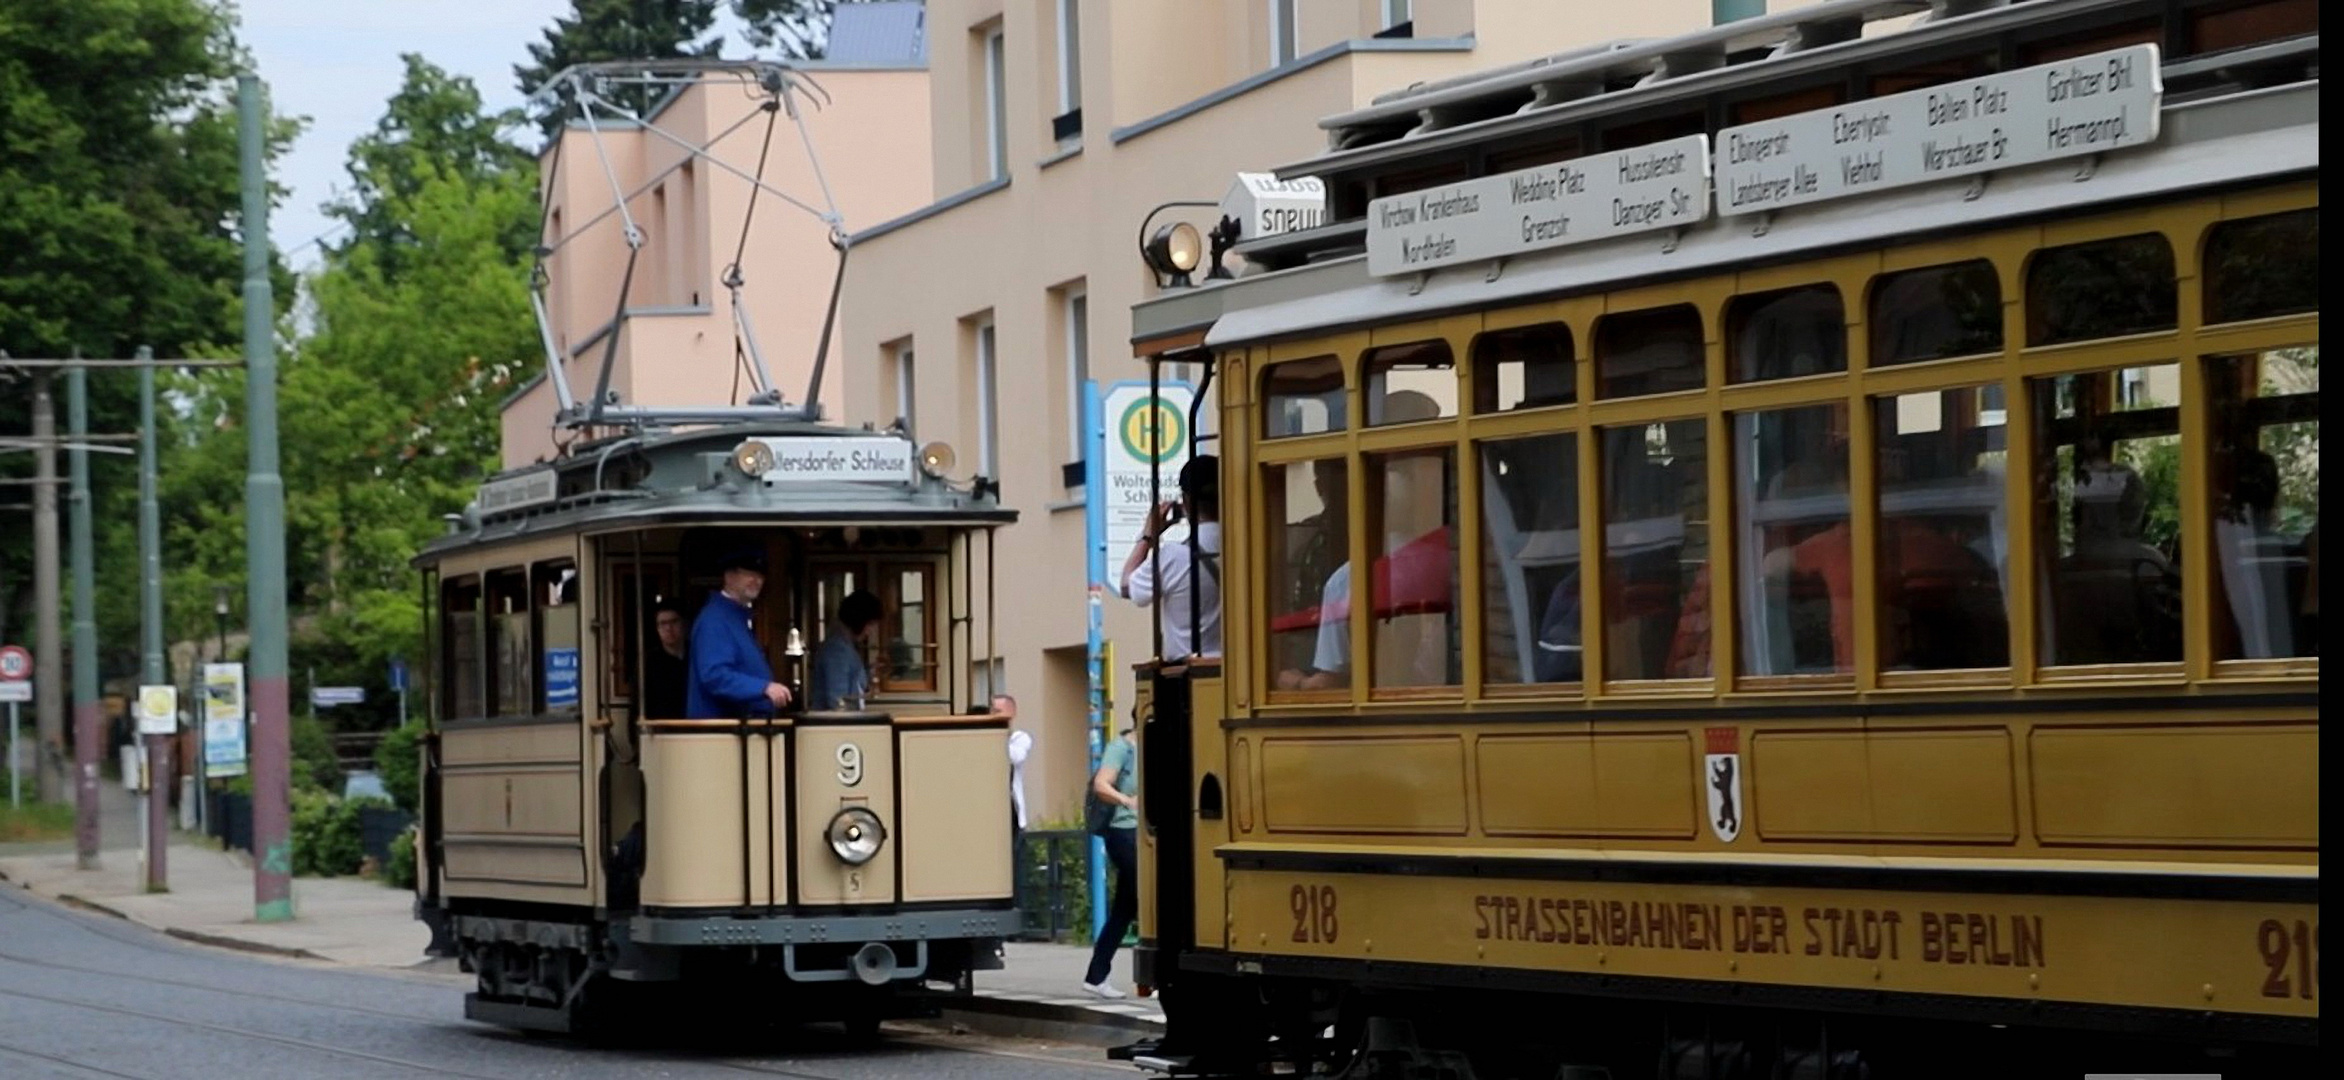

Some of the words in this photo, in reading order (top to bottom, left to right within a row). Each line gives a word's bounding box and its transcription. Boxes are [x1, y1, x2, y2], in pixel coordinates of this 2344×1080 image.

[1972, 84, 2008, 118] Platz
[1922, 135, 1989, 173] Warschauer
[1558, 165, 1585, 196] Platz
[1730, 171, 1791, 207] Landsberger
[1794, 163, 1818, 195] Allee
[1419, 189, 1480, 222] Krankenhaus
[851, 450, 904, 472] Schleuse
[837, 743, 863, 787] 9
[1289, 883, 1339, 945] 218
[1474, 894, 1721, 953] STRASSENBAHNEN
[1732, 903, 1790, 955] DER
[1804, 906, 1902, 961] STADT
[1920, 910, 2046, 968] BERLIN
[2257, 918, 2319, 1000] 21
